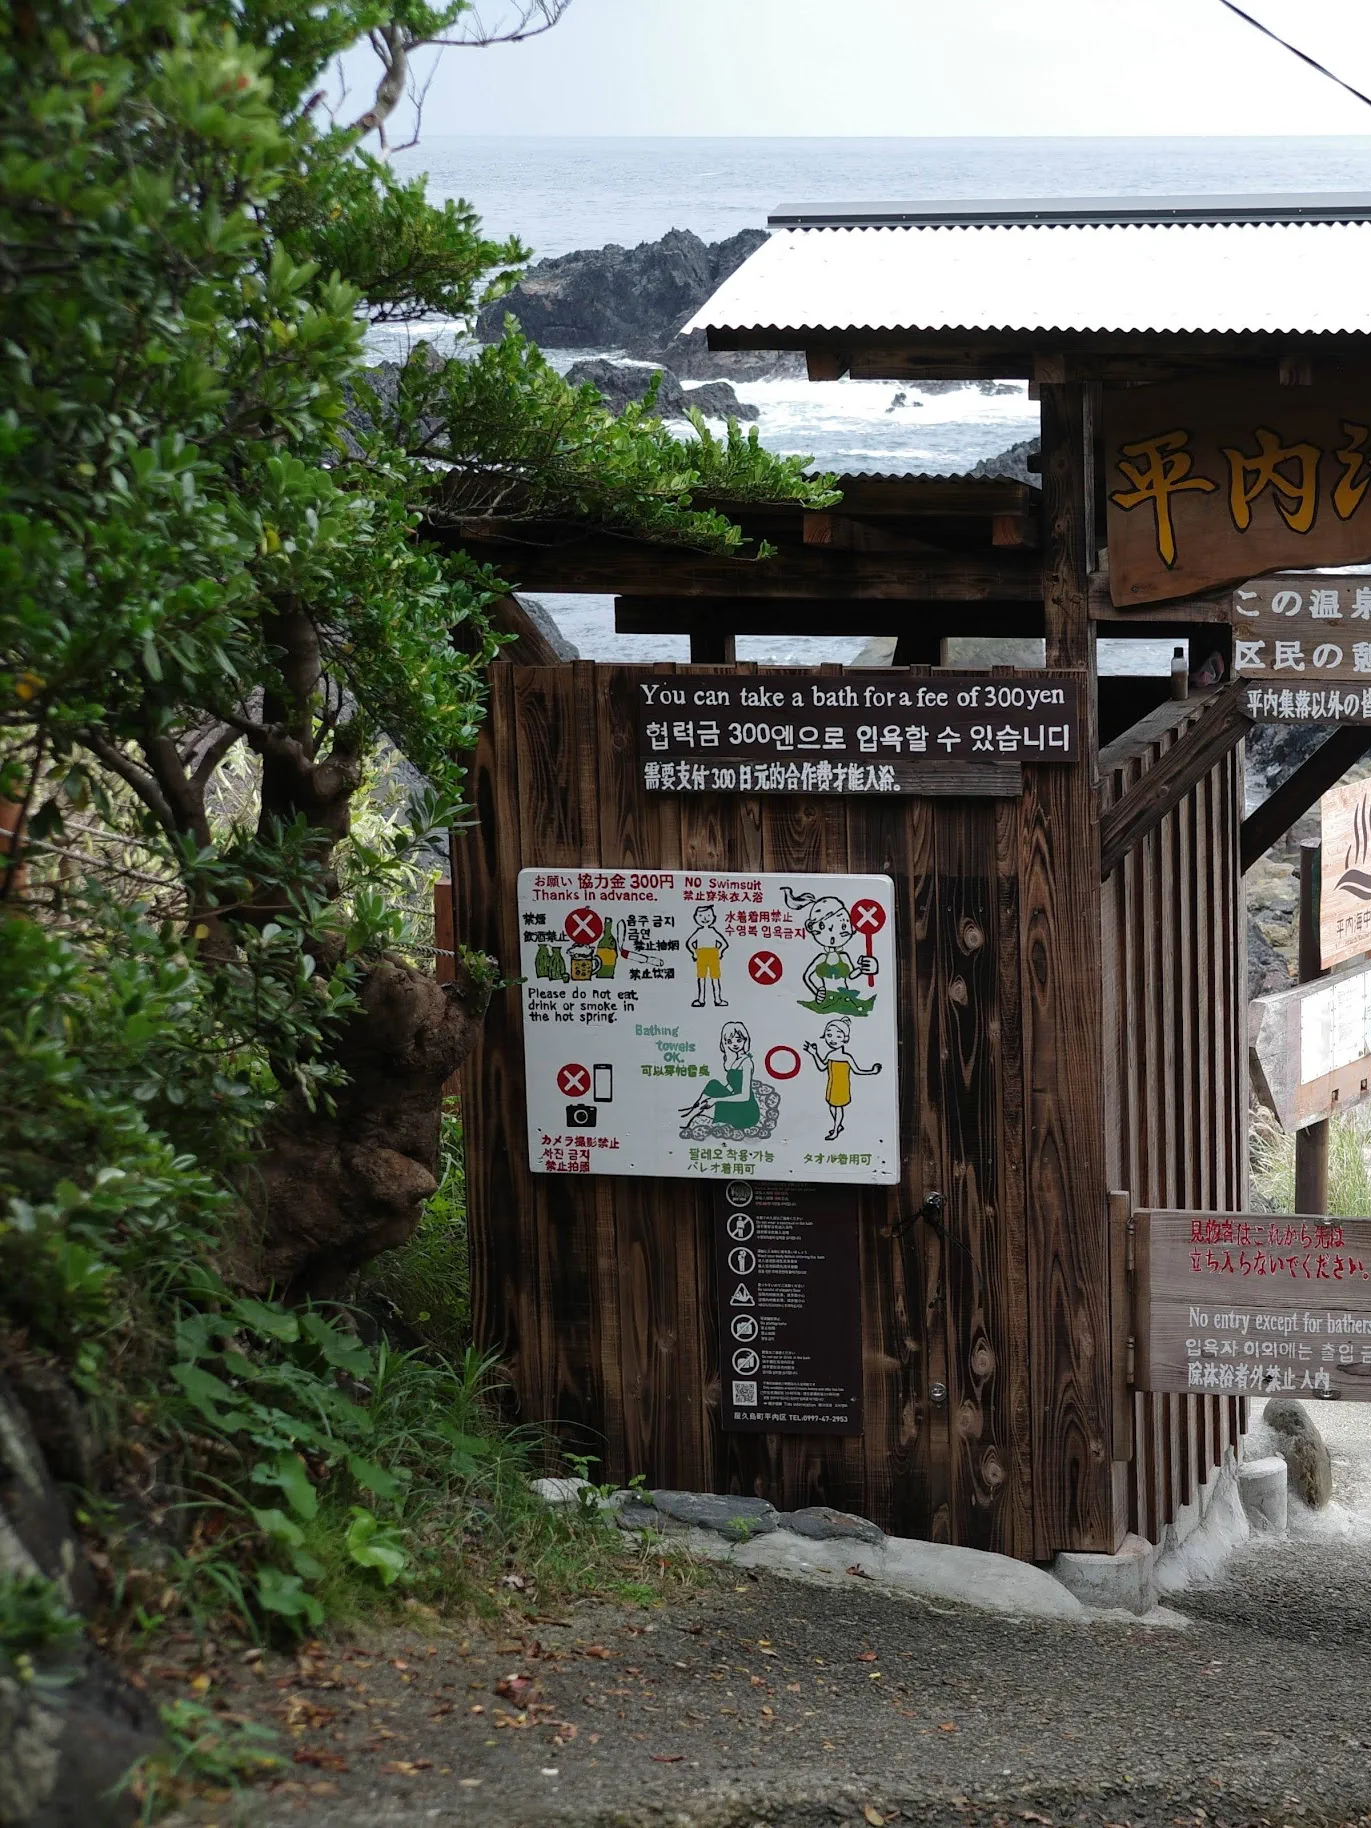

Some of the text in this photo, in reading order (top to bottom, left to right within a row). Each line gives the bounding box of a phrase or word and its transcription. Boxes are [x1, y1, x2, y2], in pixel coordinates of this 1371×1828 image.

[640, 684, 686, 705] You
[693, 690, 730, 705] can
[739, 686, 785, 707] take
[791, 691, 805, 707] a
[811, 685, 860, 707] bath
[864, 686, 898, 707] for
[899, 691, 912, 706] a
[916, 687, 949, 707] fee
[956, 686, 981, 707] of
[646, 720, 721, 750] 협력금
[728, 723, 847, 750] 300엔으로
[856, 724, 929, 753] 입욕할
[937, 726, 961, 752] 수
[534, 874, 674, 889] お願い 協力金 300円
[709, 878, 762, 890] Swimsuit
[533, 890, 658, 901] Thanks in advance.
[652, 916, 675, 927] 금지
[725, 909, 793, 923] 水着着用禁止
[627, 928, 651, 941] 금연
[528, 987, 566, 999] Please
[572, 986, 586, 999] do
[592, 988, 611, 999] not
[528, 1000, 635, 1012] drink or smoke in
[529, 1011, 618, 1025] the hot spring.
[635, 1024, 679, 1037] Bathing
[655, 1040, 696, 1052] towels
[663, 1052, 685, 1063] OK.
[568, 1149, 590, 1161] 금지
[1189, 1247, 1370, 1281] 立ち入らないでください。
[1189, 1306, 1208, 1328] No
[1214, 1311, 1250, 1335] entry
[1256, 1313, 1299, 1336] except
[1303, 1312, 1321, 1333] for
[1321, 1343, 1353, 1363] 출입
